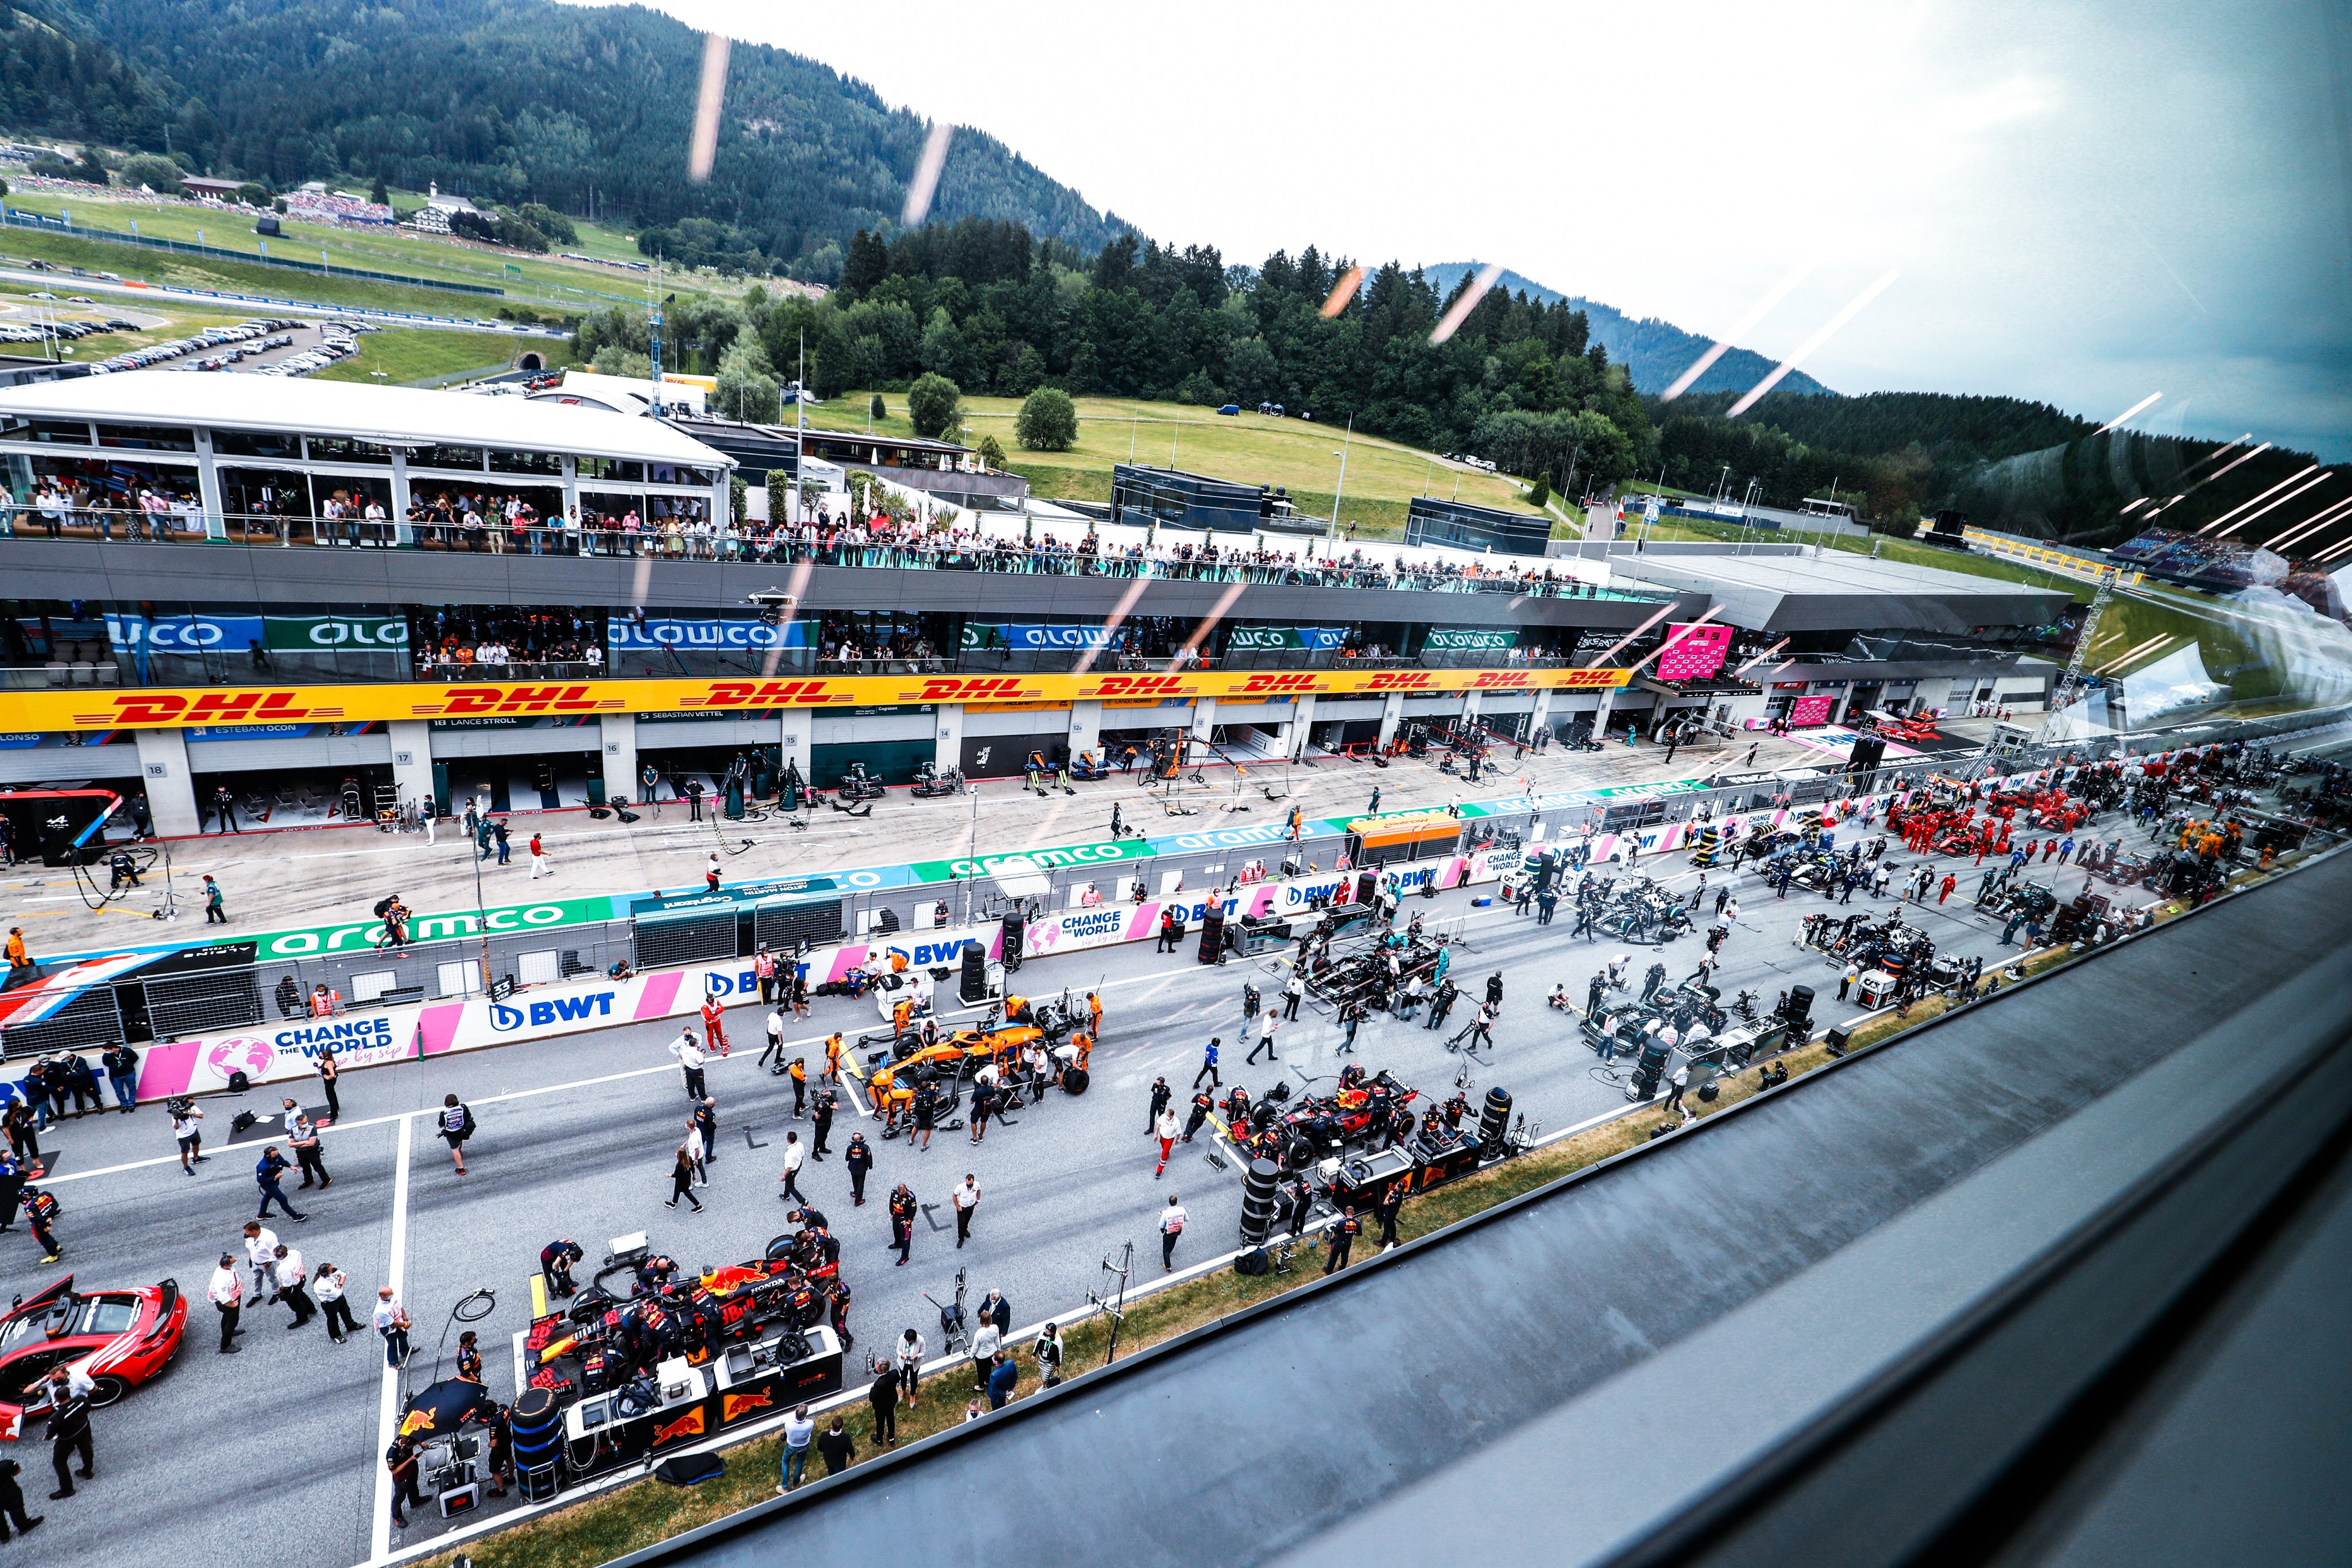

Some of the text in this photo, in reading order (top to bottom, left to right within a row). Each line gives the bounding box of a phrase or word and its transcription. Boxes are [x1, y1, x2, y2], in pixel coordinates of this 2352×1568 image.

[1242, 675, 1316, 691] DHL
[1367, 673, 1432, 688] DHL
[1472, 672, 1530, 687] DHL
[1563, 671, 1615, 685] DHL
[705, 682, 832, 704] DHL
[919, 679, 1024, 699] DHL
[1096, 677, 1184, 695] DHL
[113, 693, 310, 722] DHL
[443, 687, 598, 713] DHL
[451, 718, 481, 726] LANCE
[215, 726, 264, 734] ESTEBAN
[1612, 782, 1694, 797] aramco
[2012, 778, 2025, 788] BWT
[1496, 793, 1596, 811] armco
[1384, 818, 1429, 828] McLaren
[1748, 814, 1771, 822] CHANGE
[1641, 834, 1657, 849] WT
[1487, 851, 1523, 864] CHANGE
[1492, 860, 1520, 871] WORLD
[744, 887, 781, 896] MARTIN
[1303, 883, 1336, 904] BW
[663, 896, 733, 909] Cognizant
[1062, 911, 1121, 929] CHANGE
[271, 906, 564, 954] aramco
[1074, 923, 1119, 938] WORLD
[800, 940, 806, 950] 4
[798, 948, 808, 958] NOR
[738, 962, 811, 994] BT
[850, 976, 857, 984] 4
[494, 980, 510, 996] 33
[496, 990, 510, 1001] VER
[530, 992, 614, 1026] BWT
[276, 1018, 390, 1047] CHANGE
[278, 1034, 392, 1058] THE WORLD
[355, 1044, 372, 1064] by
[378, 1045, 401, 1059] sip
[1385, 1070, 1411, 1091] HONDA
[810, 1264, 834, 1276] ESSO
[751, 1278, 786, 1294] HONDA
[532, 1315, 550, 1324] telcel
